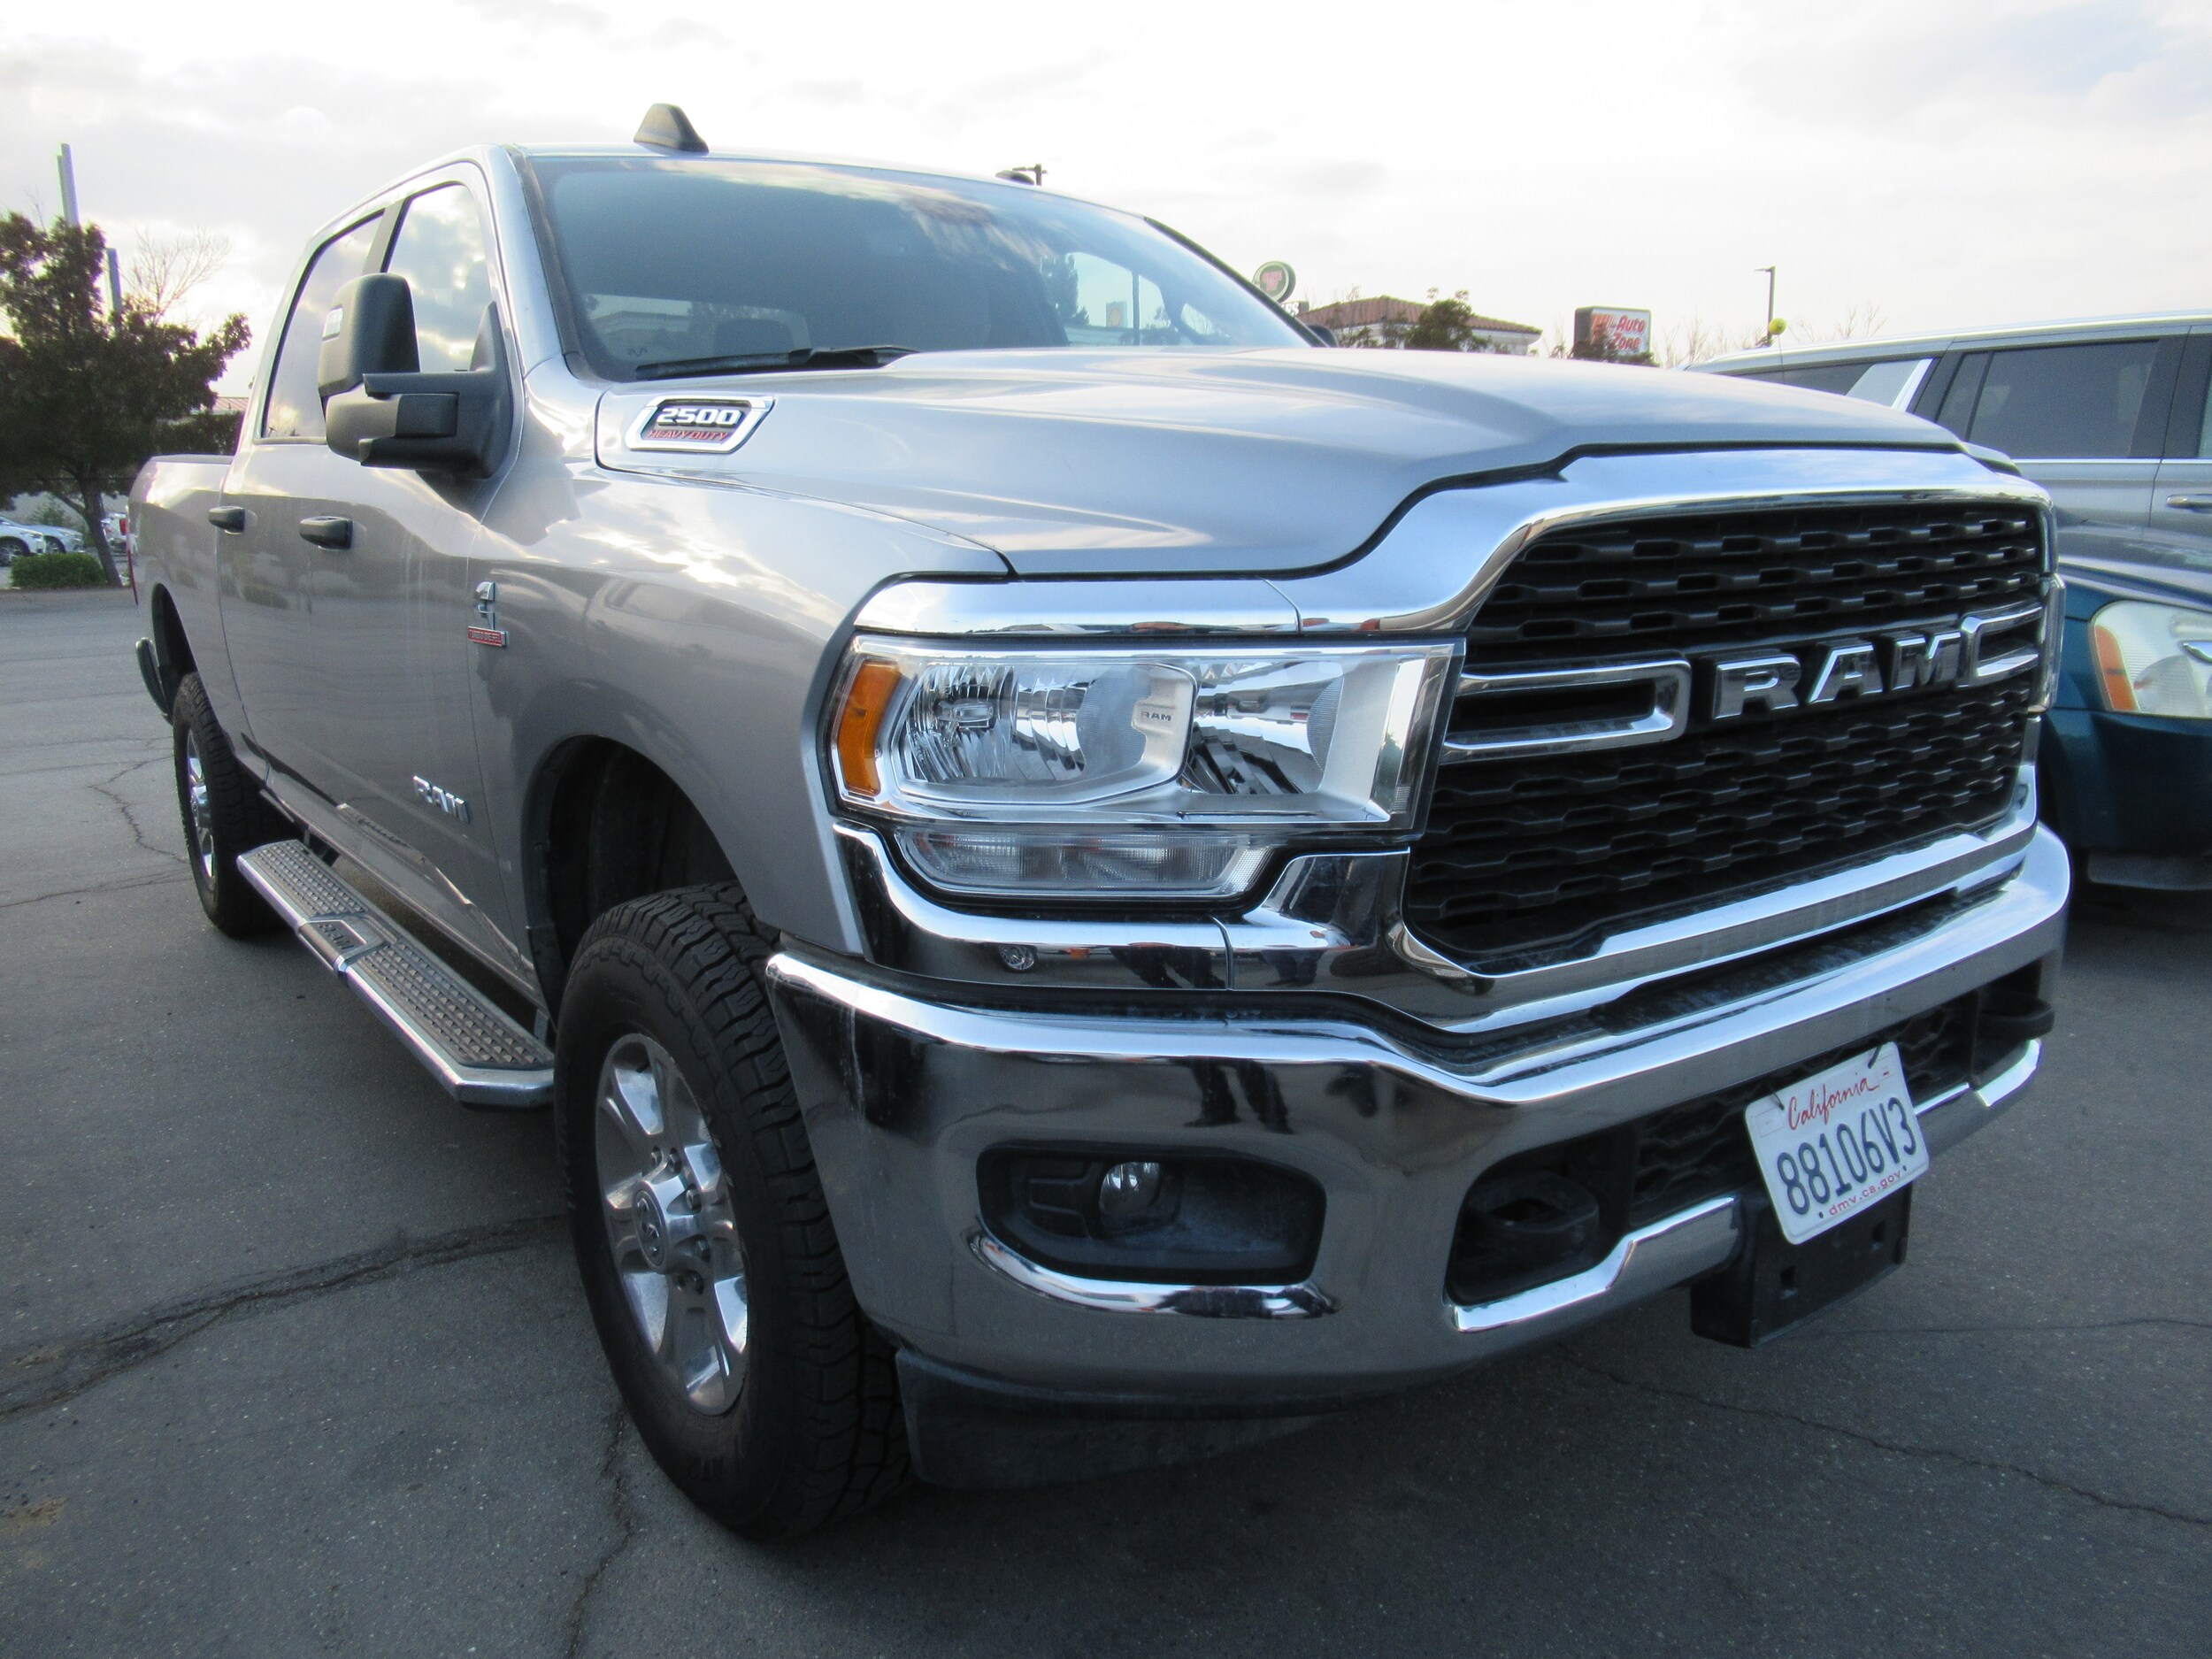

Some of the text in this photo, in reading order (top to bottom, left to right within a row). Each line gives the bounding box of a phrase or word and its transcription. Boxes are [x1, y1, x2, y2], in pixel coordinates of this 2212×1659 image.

[1616, 315, 1646, 334] Auto
[648, 429, 729, 441] HEAVY DUTY
[656, 408, 742, 427] 2500
[1712, 631, 1962, 719] RAM
[1140, 710, 1172, 722] RAM
[412, 775, 470, 823] RAM
[1788, 1072, 1879, 1131] California
[1777, 1096, 1916, 1216] 88106V3
[1828, 1170, 1901, 1217] dmv.ca.gov
